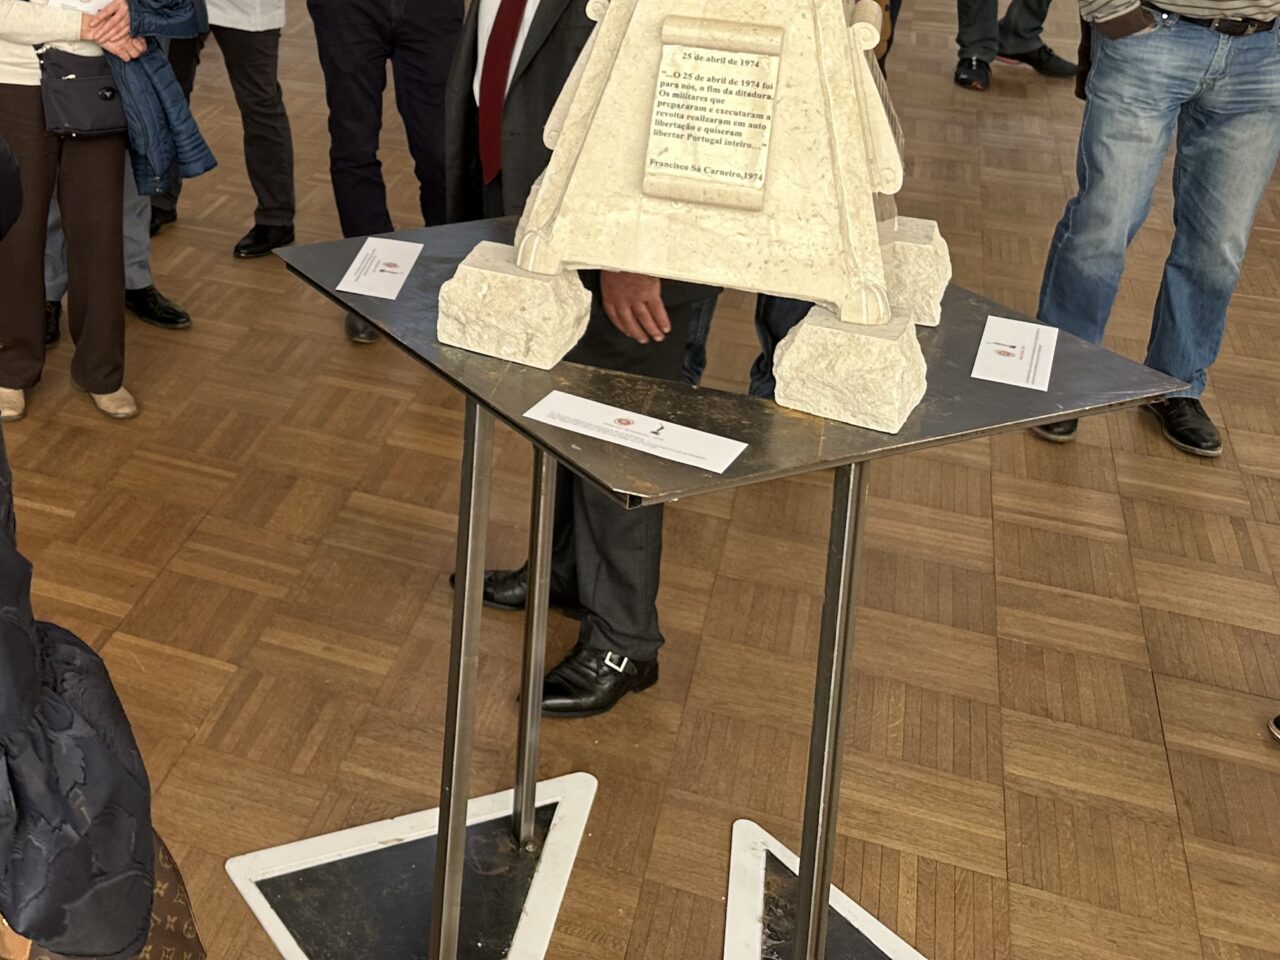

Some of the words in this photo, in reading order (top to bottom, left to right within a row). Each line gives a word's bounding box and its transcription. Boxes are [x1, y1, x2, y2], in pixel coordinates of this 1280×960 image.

[694, 53, 703, 61] de
[706, 56, 725, 64] abril
[728, 57, 738, 65] de
[740, 59, 759, 68] 1974
[707, 75, 726, 84] abril
[728, 77, 738, 85] de
[741, 79, 760, 88] 1974
[672, 91, 708, 102] militares
[710, 96, 725, 105] que
[681, 82, 696, 91] nós,
[707, 85, 720, 94] fim
[723, 87, 733, 95] da
[736, 88, 774, 100] ditadura.
[657, 100, 706, 112] prepararam
[715, 108, 764, 120] executaram
[654, 119, 695, 131] libertação
[704, 127, 742, 137] quiseram
[656, 110, 684, 120] revolta
[686, 114, 731, 126] realizaram
[748, 121, 766, 130] auto
[653, 129, 684, 139] libertar
[686, 133, 722, 145] Portugal
[649, 158, 688, 170] Francisco
